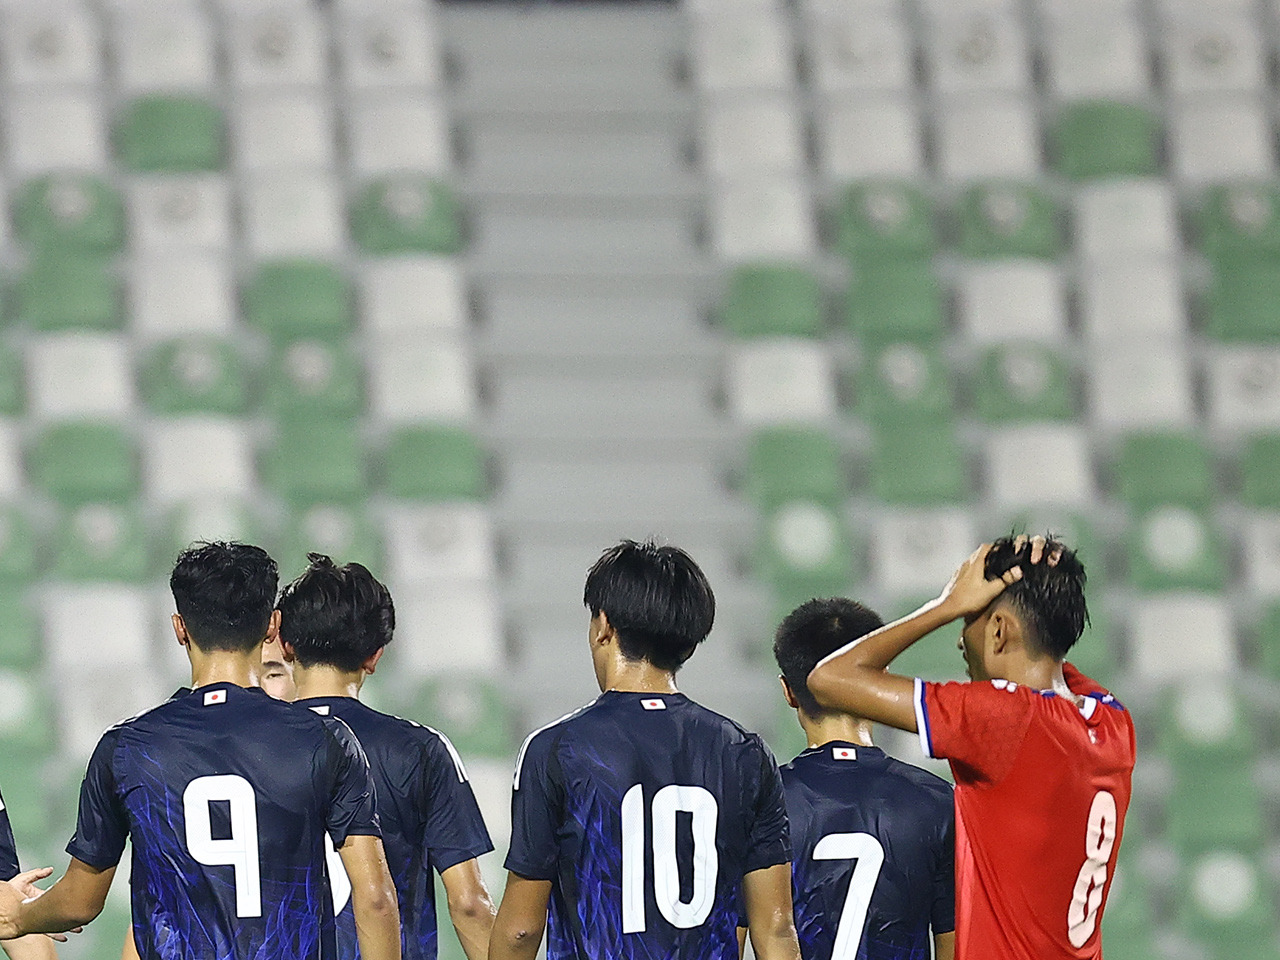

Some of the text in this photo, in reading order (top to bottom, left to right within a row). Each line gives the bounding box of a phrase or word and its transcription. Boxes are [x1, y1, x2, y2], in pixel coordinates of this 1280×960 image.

[182, 774, 261, 918] 9
[621, 783, 719, 934] 10
[1067, 790, 1117, 950] 8
